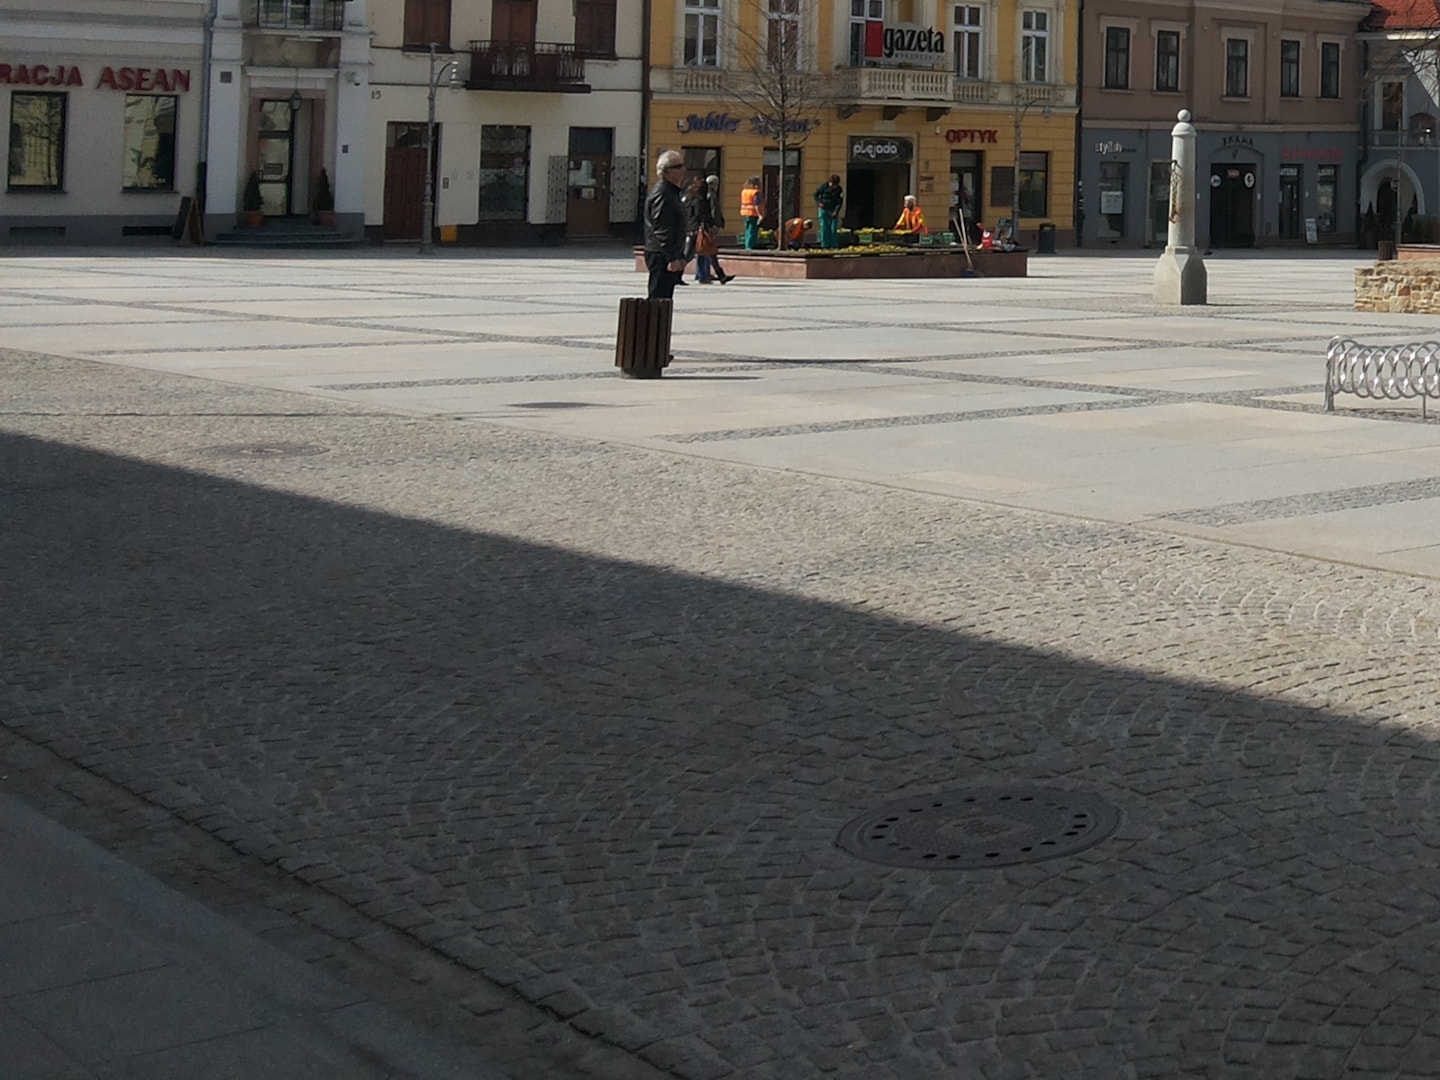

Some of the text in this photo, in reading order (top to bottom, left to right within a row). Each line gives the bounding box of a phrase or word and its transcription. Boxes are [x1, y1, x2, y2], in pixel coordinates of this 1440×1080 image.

[884, 26, 945, 58] gazeta
[0, 63, 191, 92] RACJA ASEAN
[946, 129, 998, 143] OPTYK
[853, 139, 898, 158] plejada
